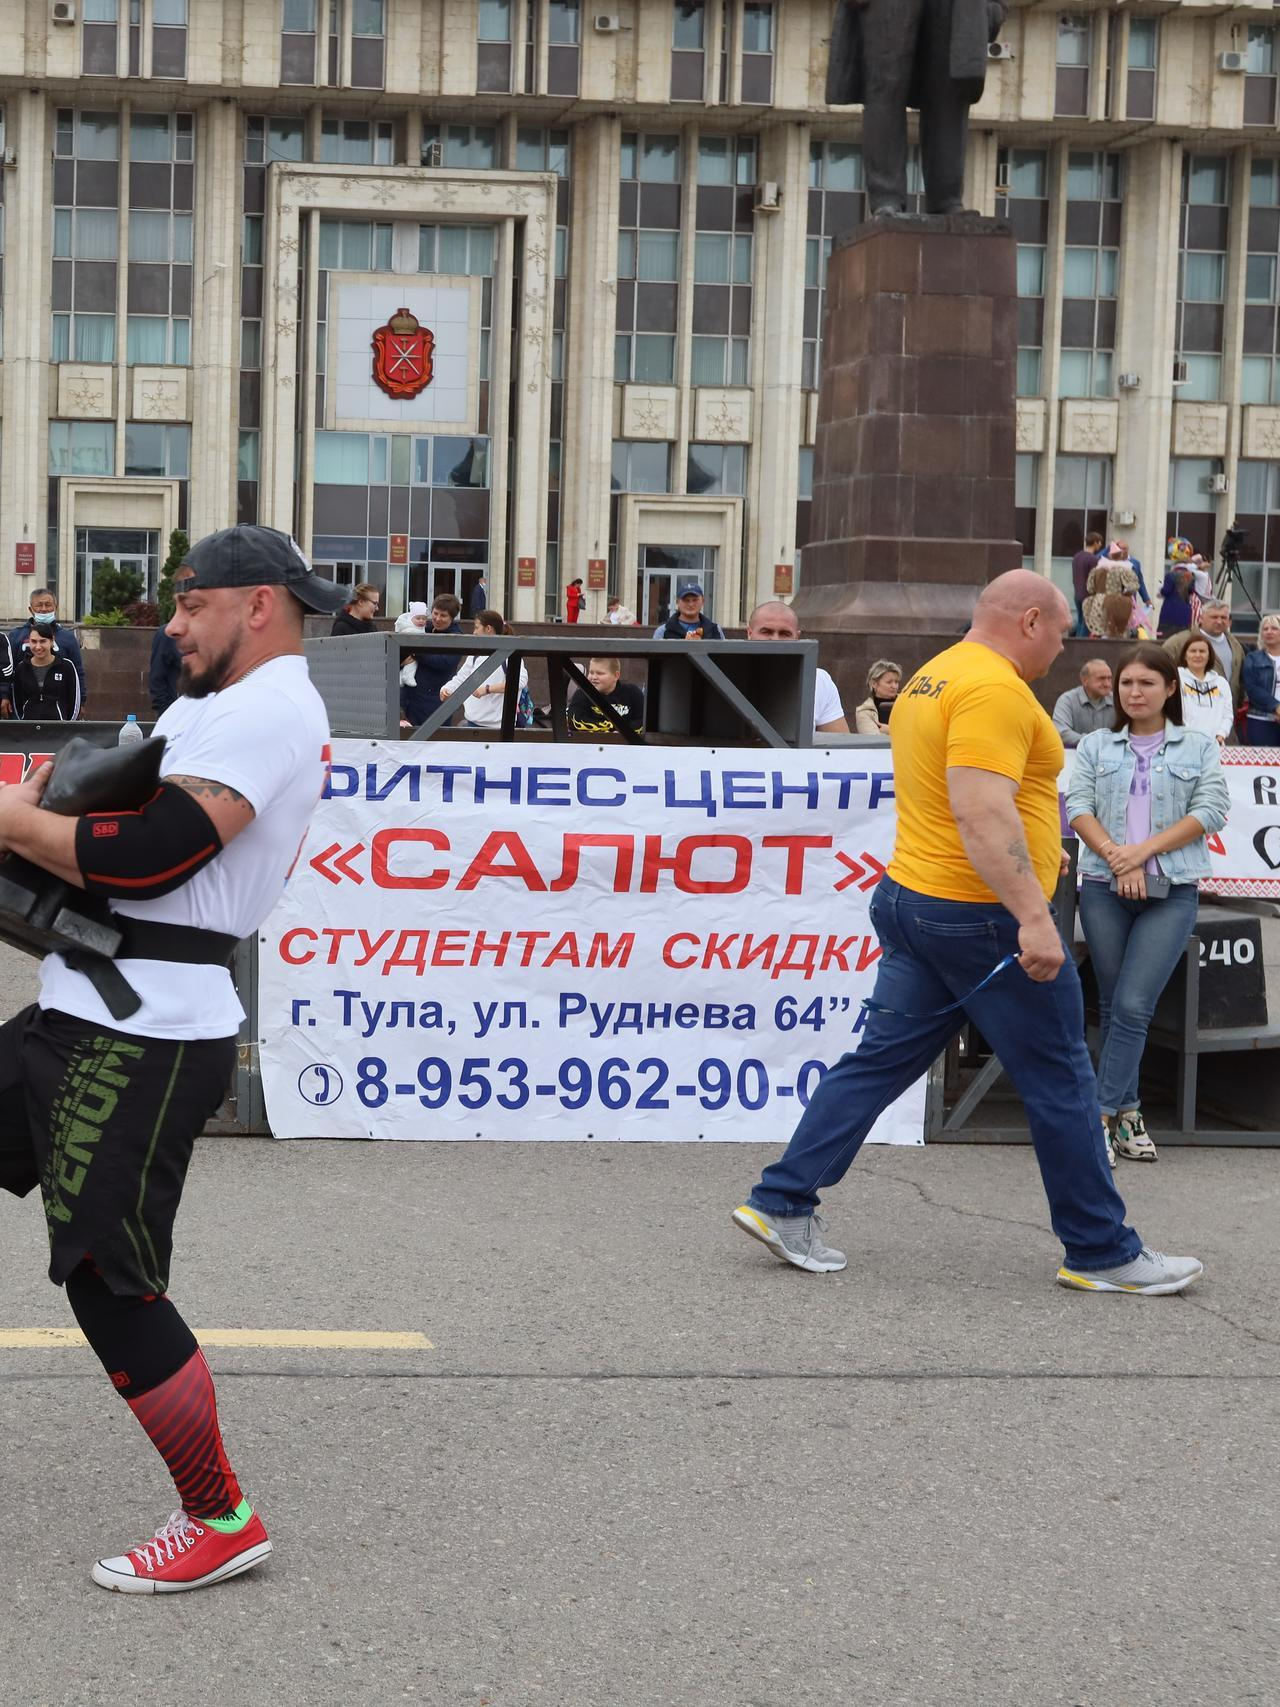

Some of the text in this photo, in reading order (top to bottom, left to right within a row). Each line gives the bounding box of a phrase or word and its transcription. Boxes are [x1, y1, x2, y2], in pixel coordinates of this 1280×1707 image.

[95, 824, 116, 835] SBD
[309, 827, 887, 895] «САЛЮТ»
[278, 927, 635, 977] СТУДЕНТАМ
[292, 999, 317, 1027] г.
[333, 989, 456, 1037] Тула,
[473, 1001, 540, 1038] ул.
[559, 992, 756, 1038] Руднева
[355, 1056, 829, 1111] 8-953-962-90-0
